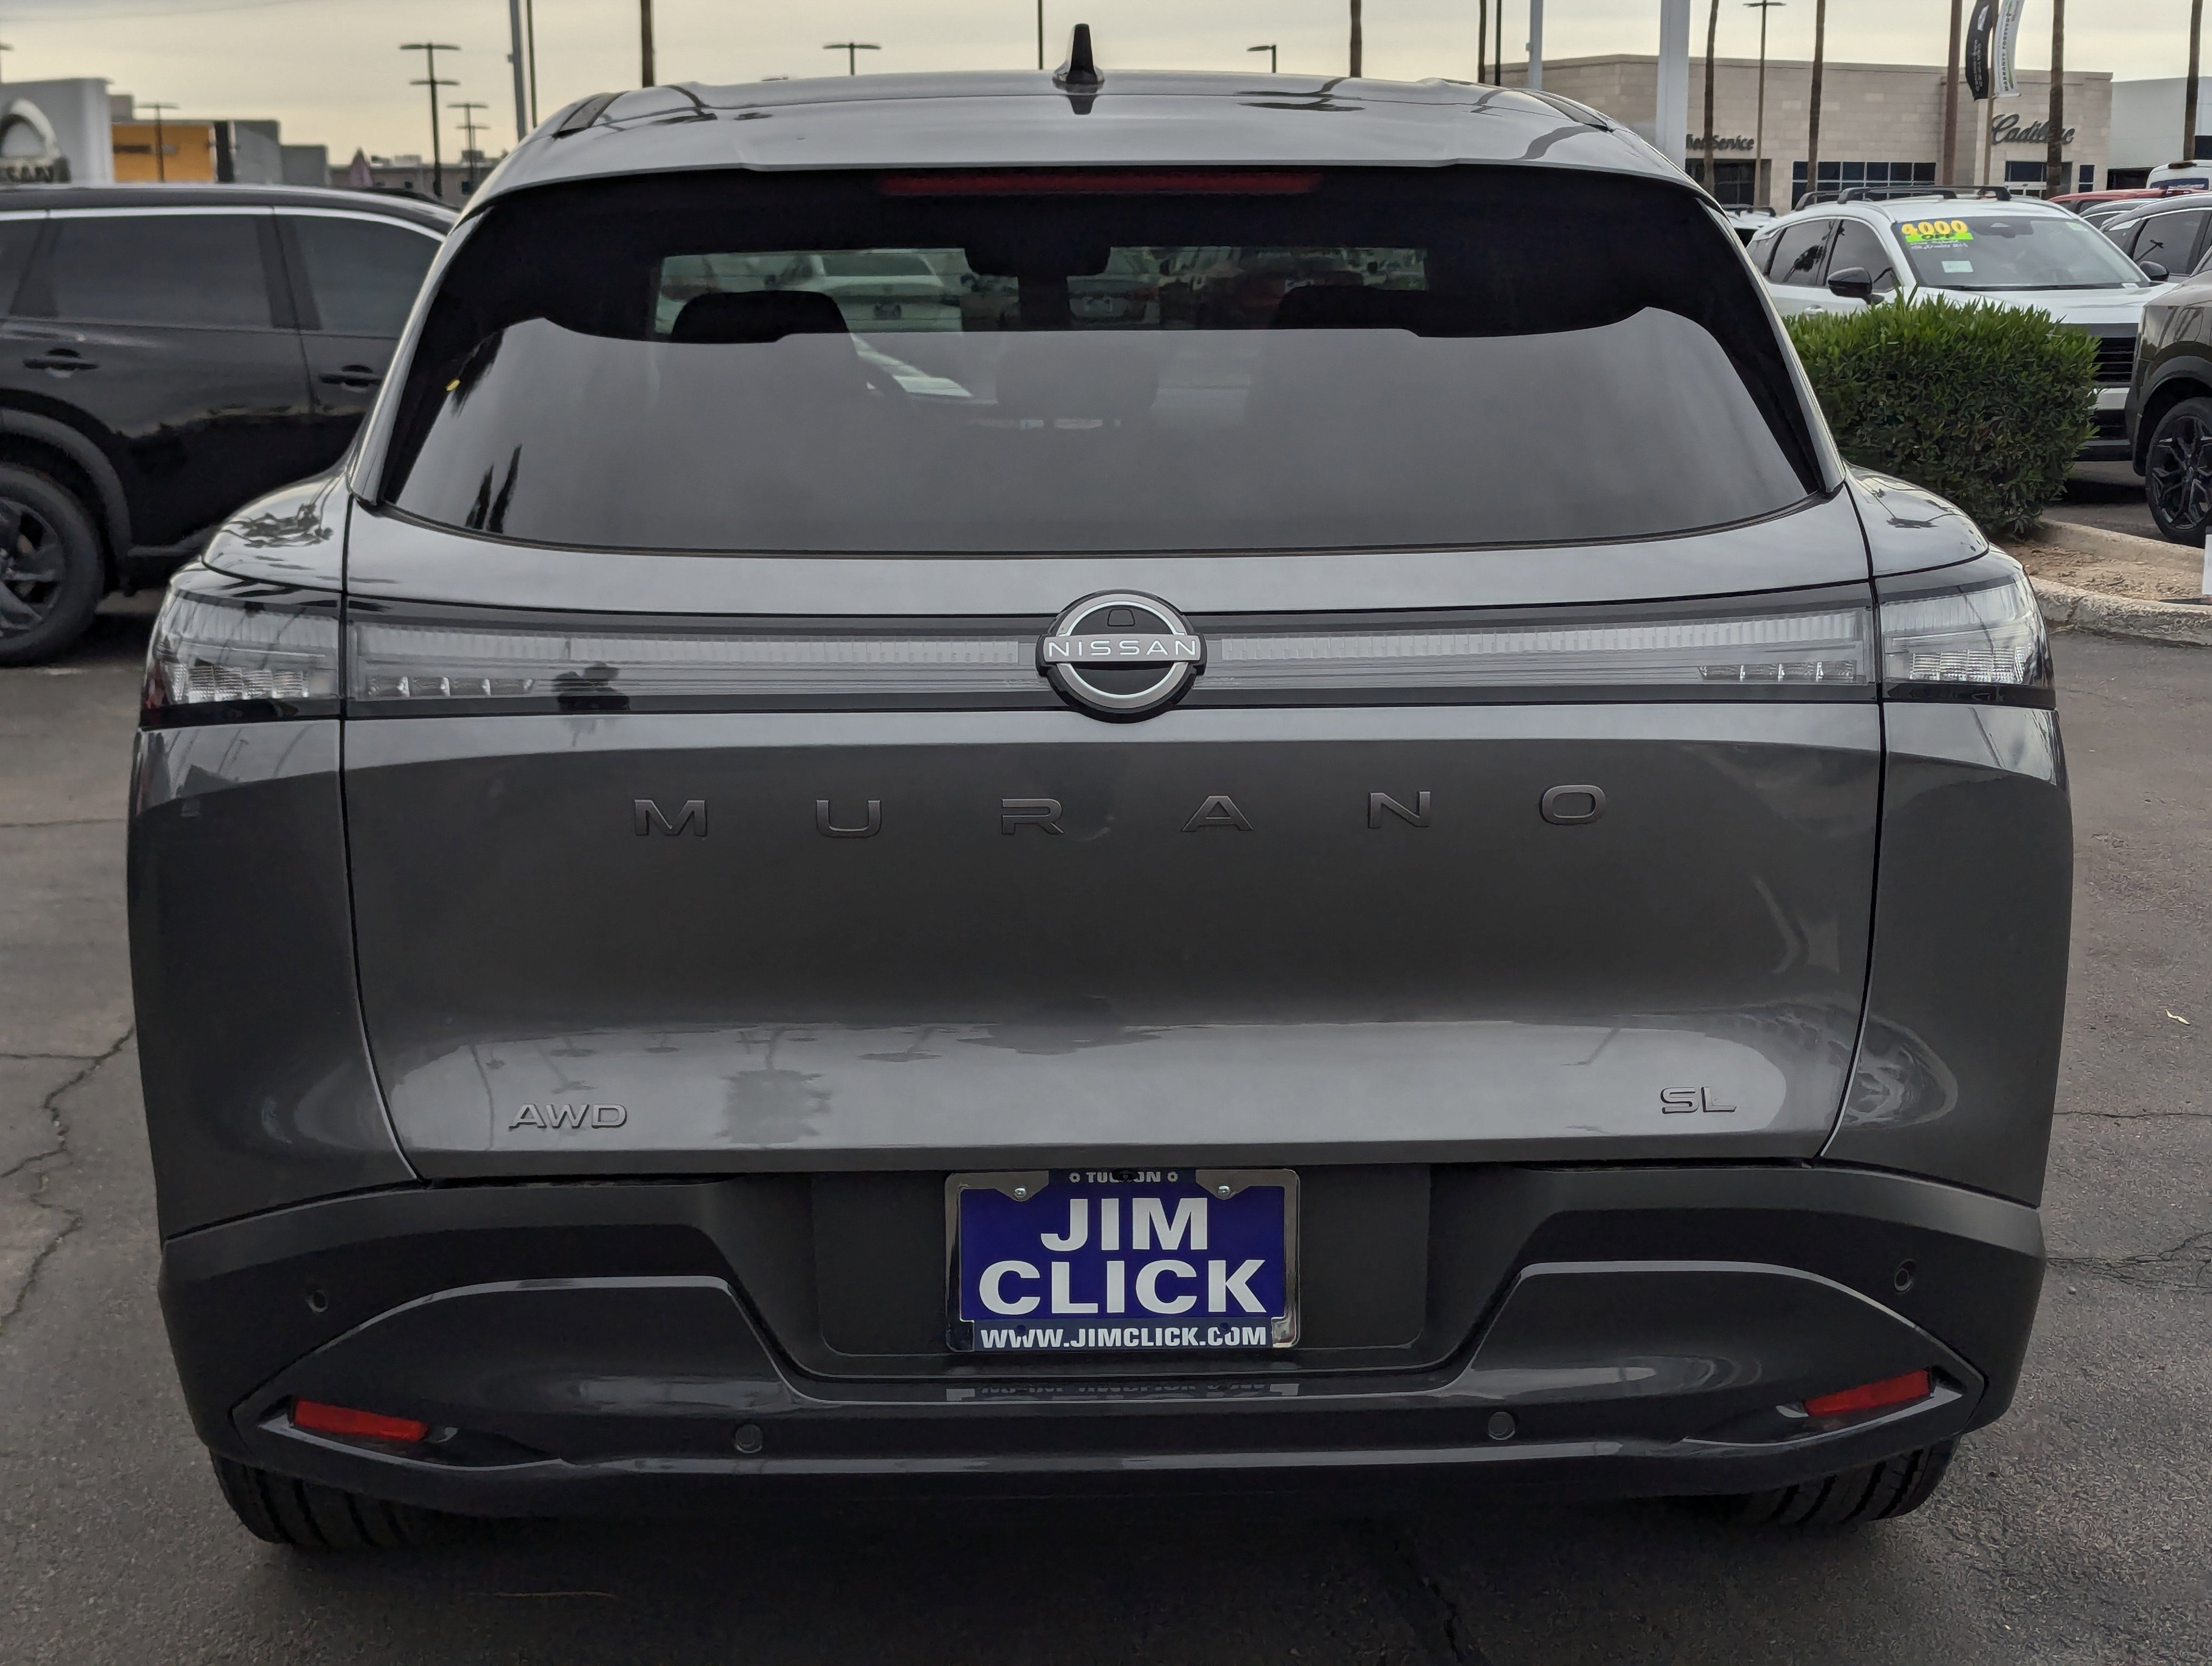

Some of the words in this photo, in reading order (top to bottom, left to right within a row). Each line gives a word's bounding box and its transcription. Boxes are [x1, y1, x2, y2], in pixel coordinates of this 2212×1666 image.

[1049, 639, 1195, 658] NISSAN
[634, 784, 1606, 838] MURANO
[1660, 1086, 1737, 1114] SL
[509, 1104, 627, 1130] AWD
[1086, 1171, 1161, 1183] TUCON
[1040, 1197, 1208, 1251] JIM
[979, 1259, 1267, 1315] CLICK
[981, 1326, 1266, 1348] WWW.JIMCLICK.COM
